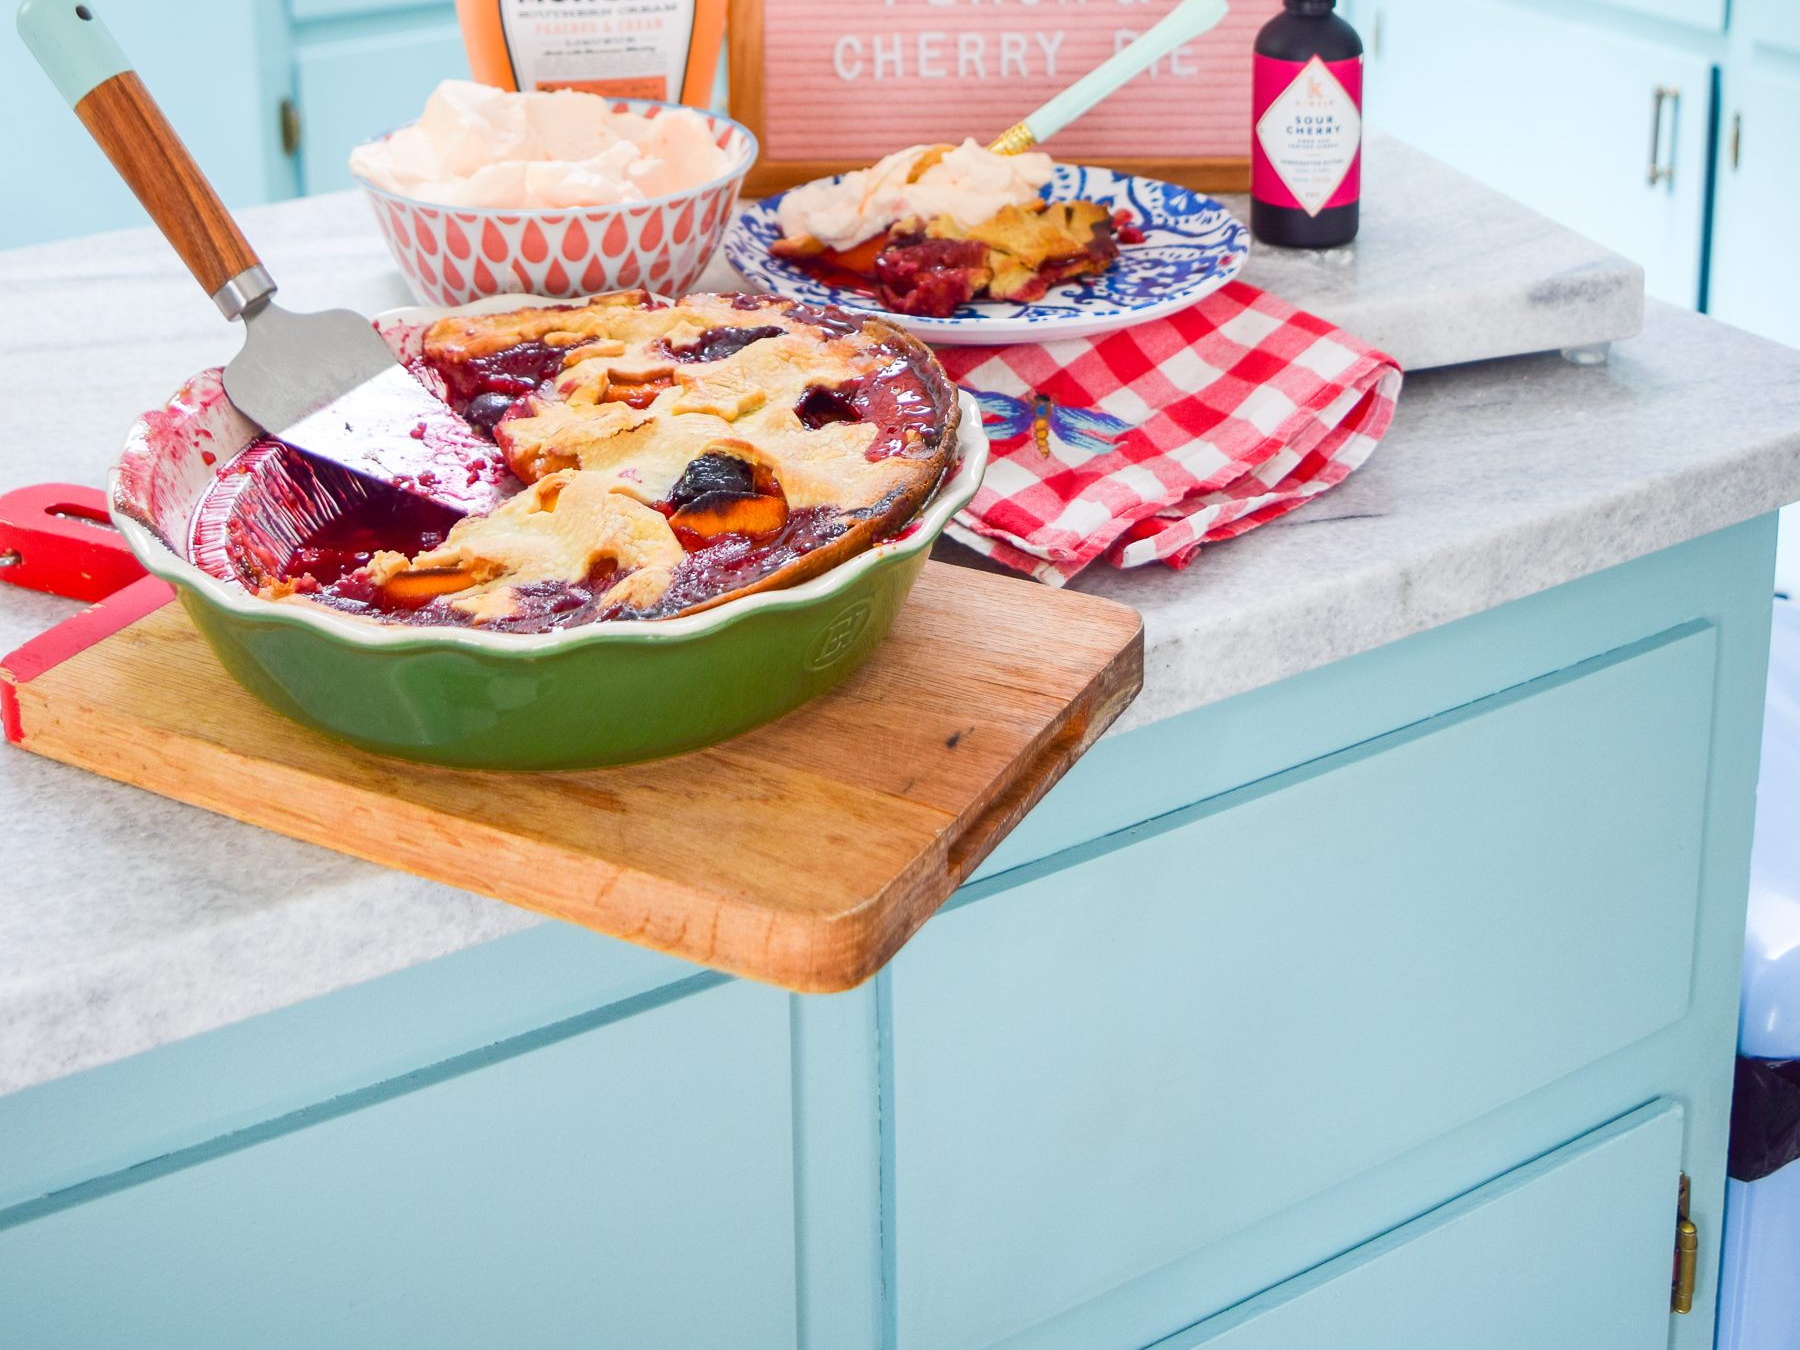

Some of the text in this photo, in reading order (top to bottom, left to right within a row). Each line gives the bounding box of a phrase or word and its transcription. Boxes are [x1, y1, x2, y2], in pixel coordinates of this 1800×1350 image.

[536, 20, 598, 35] PEACHES
[618, 17, 664, 31] CREAM
[833, 30, 1065, 81] CHERRY
[1295, 115, 1333, 125] SOUR
[1286, 124, 1341, 135] CHERRY
